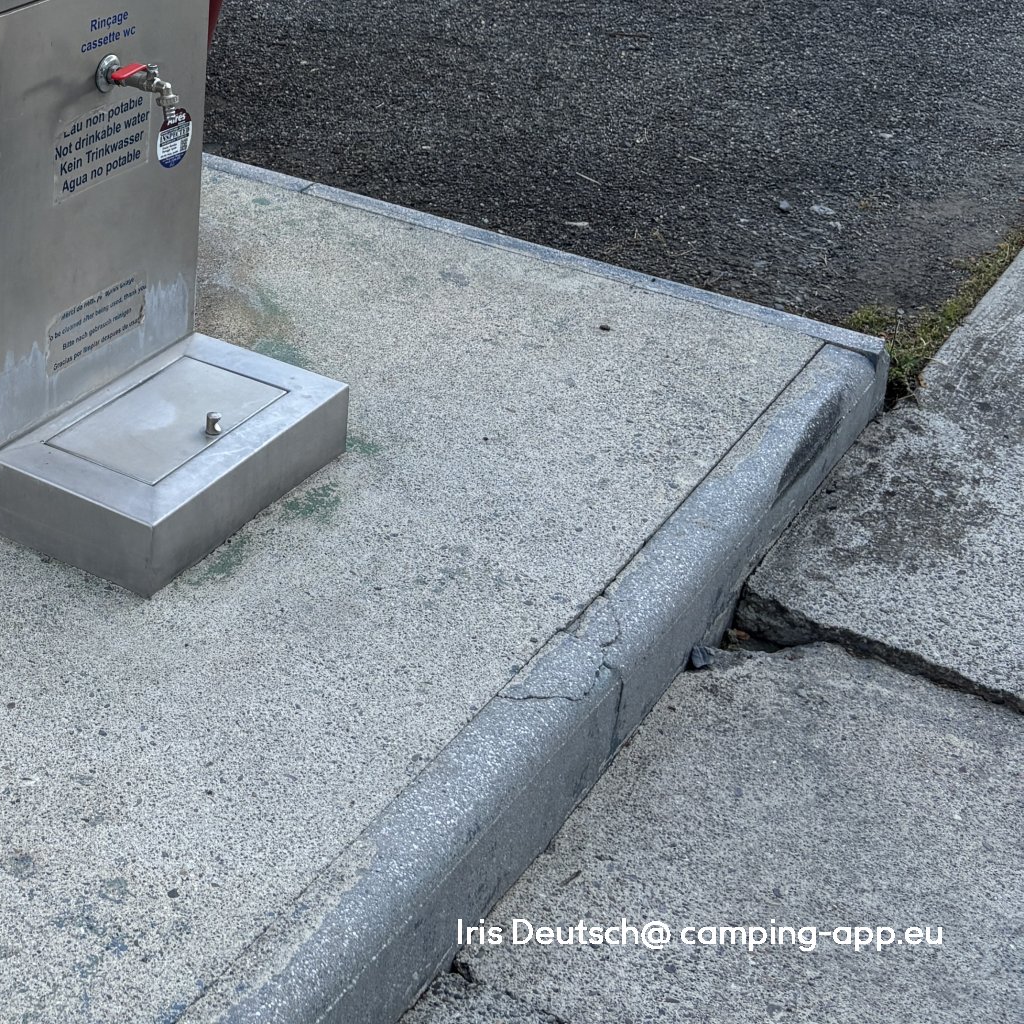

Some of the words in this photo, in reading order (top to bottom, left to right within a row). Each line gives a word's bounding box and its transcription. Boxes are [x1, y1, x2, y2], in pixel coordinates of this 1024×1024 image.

[80, 30, 121, 53] cassette
[122, 25, 136, 38] wc
[90, 10, 129, 32] Rinçage
[55, 142, 73, 160] Not
[75, 122, 122, 151] drinkable
[124, 110, 150, 130] water
[86, 112, 105, 129] non
[60, 157, 82, 176] Kein
[86, 130, 144, 164] Trinkwasser
[62, 173, 88, 193] Agua
[90, 166, 104, 180] no
[106, 149, 141, 176] potable
